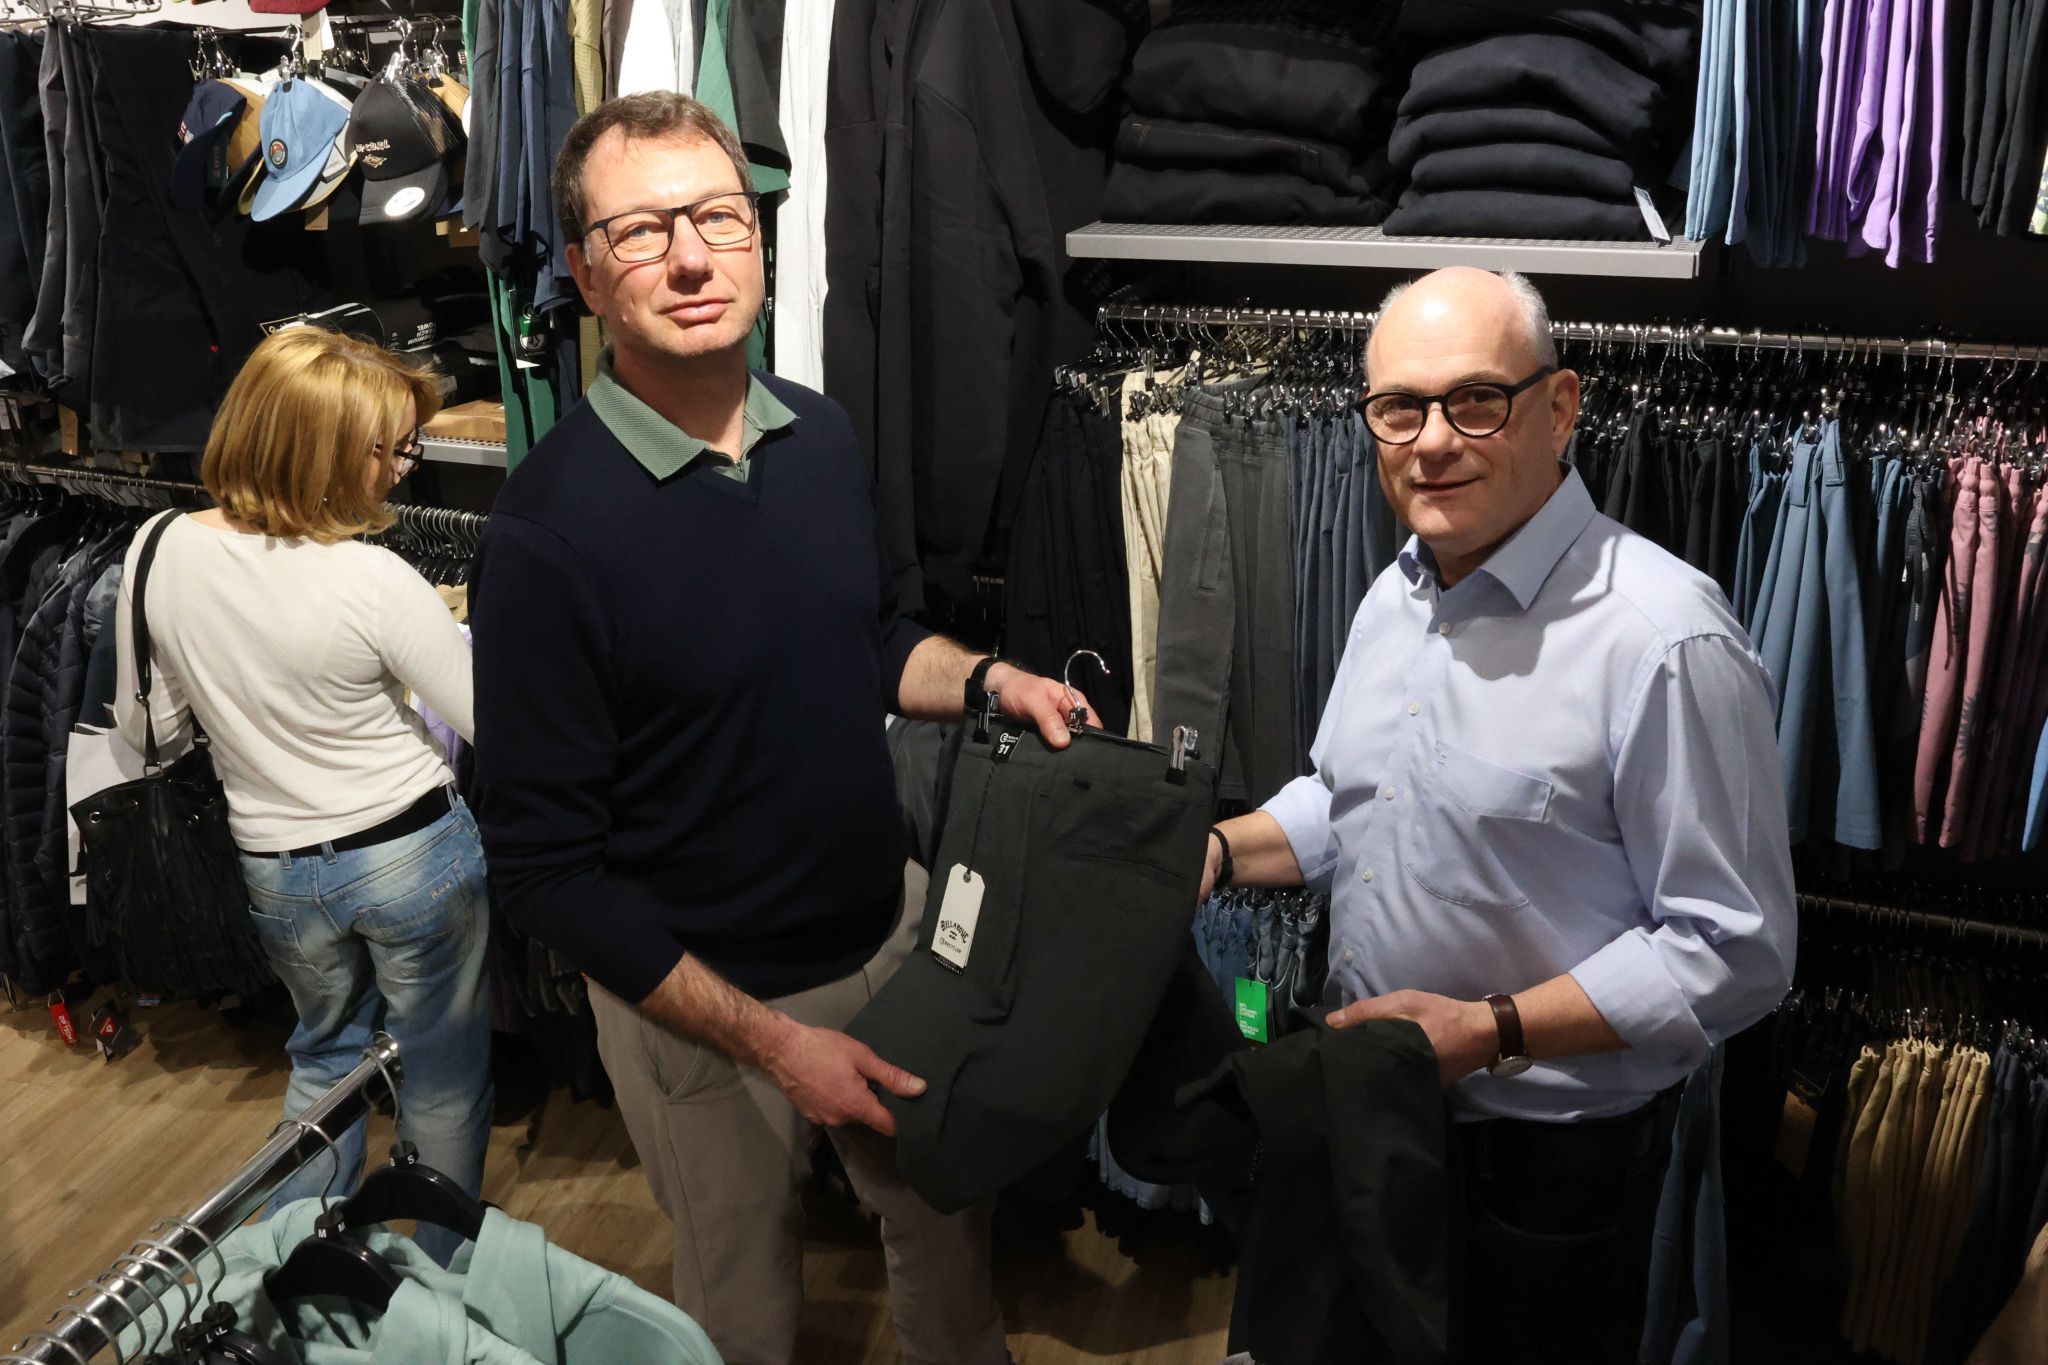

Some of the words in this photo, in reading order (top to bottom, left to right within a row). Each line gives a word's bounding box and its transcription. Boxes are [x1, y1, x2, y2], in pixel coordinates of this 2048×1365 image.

[416, 321, 435, 331] OWEL
[998, 744, 1010, 755] 31
[63, 1025, 73, 1040] TECH
[407, 1155, 415, 1165] S
[337, 1221, 346, 1233] M
[318, 1228, 327, 1238] M
